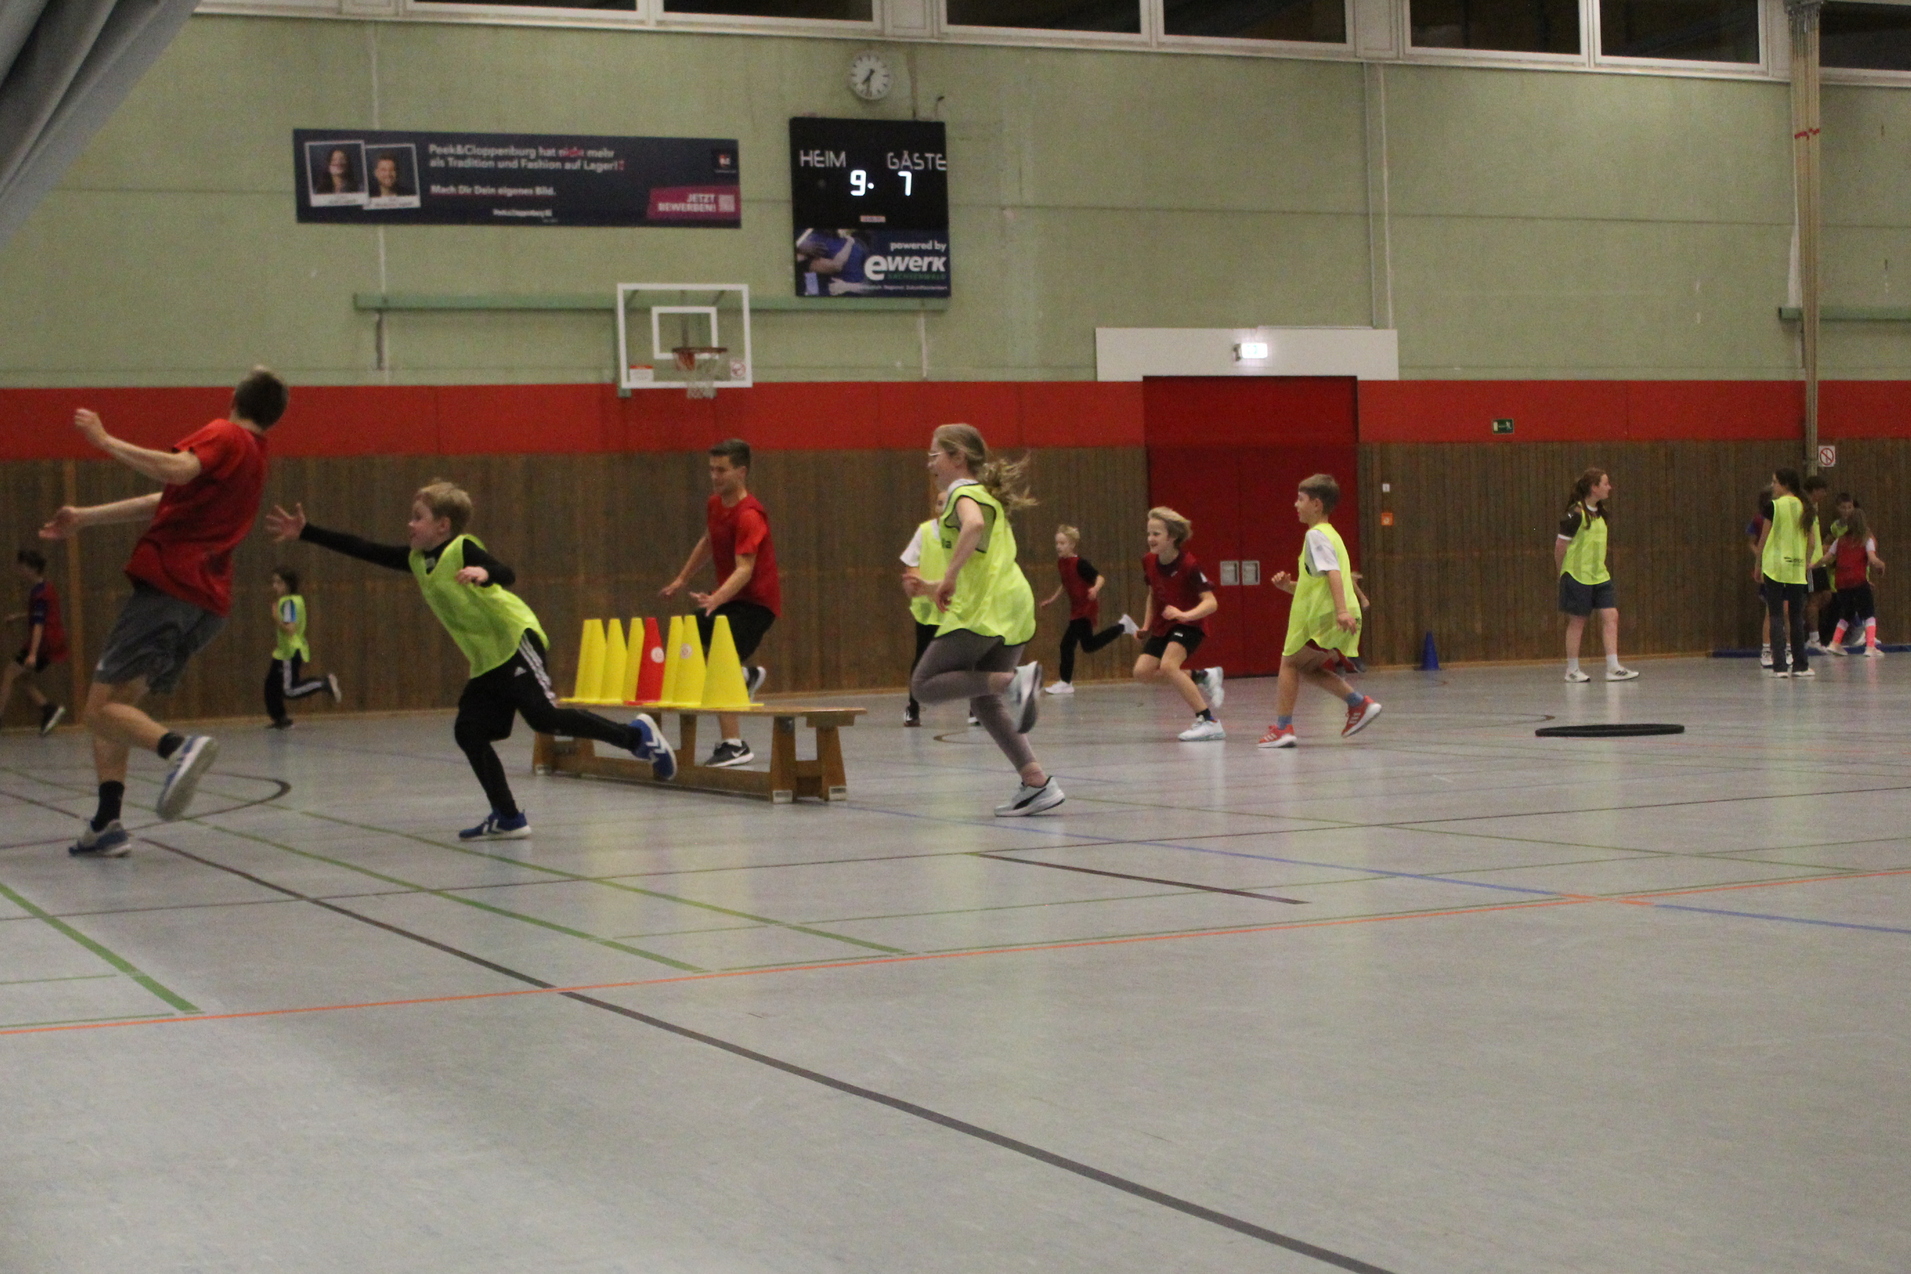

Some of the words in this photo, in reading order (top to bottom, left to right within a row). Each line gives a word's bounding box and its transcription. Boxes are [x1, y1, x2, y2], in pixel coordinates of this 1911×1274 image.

[538, 145, 556, 156] hat
[586, 147, 614, 158] mehr
[430, 157, 445, 168] als
[447, 157, 495, 168] Tradition
[497, 159, 519, 169] und
[520, 159, 562, 170] Fashion
[563, 159, 582, 170] auf
[800, 150, 846, 168] HEIM
[887, 151, 948, 171] GÄSTE
[897, 170, 912, 197] 7
[431, 185, 456, 195] Mach
[458, 185, 472, 195] Dir
[474, 185, 496, 196] Dein
[687, 193, 715, 203] JETZT
[658, 202, 717, 213] BEWERBEN!
[890, 240, 933, 252] powered
[934, 240, 947, 253] by
